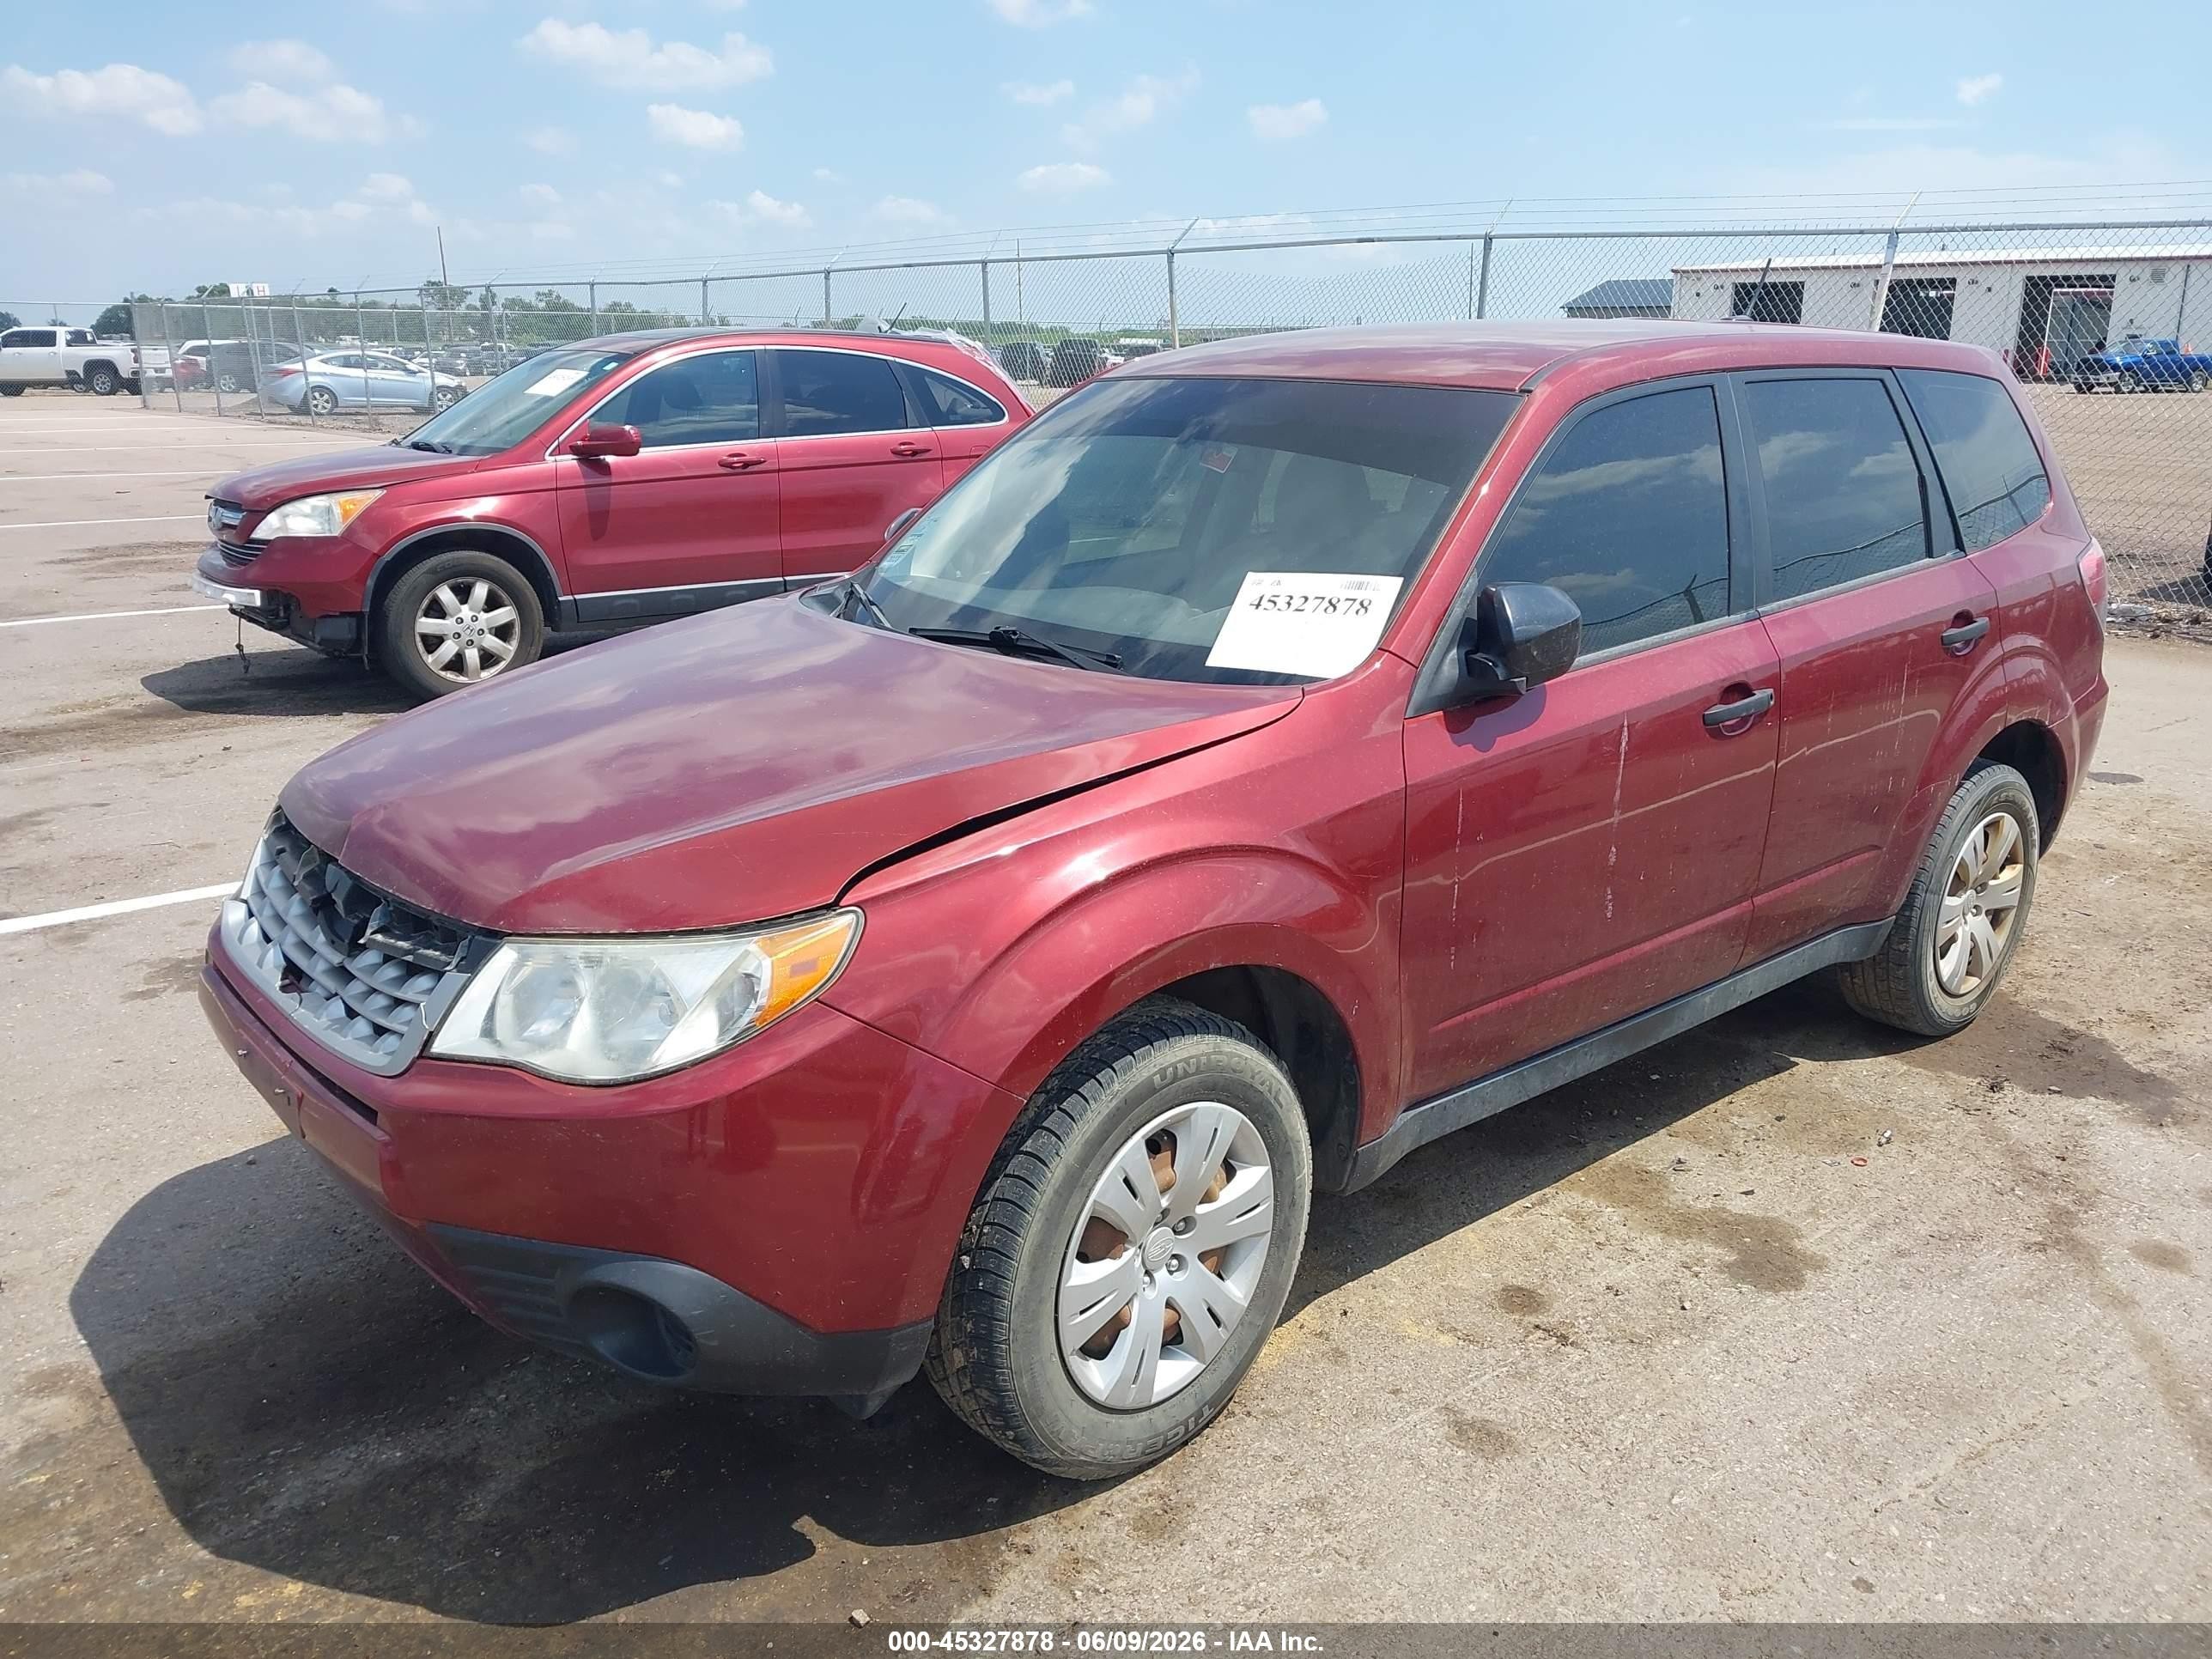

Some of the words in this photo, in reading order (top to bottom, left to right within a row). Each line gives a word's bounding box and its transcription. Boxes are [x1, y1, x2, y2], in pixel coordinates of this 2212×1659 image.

[256, 285, 266, 296] H
[1249, 593, 1373, 617] 45327878
[1152, 1054, 1286, 1110] UNIROYAL
[1121, 1404, 1215, 1459] TIGER
